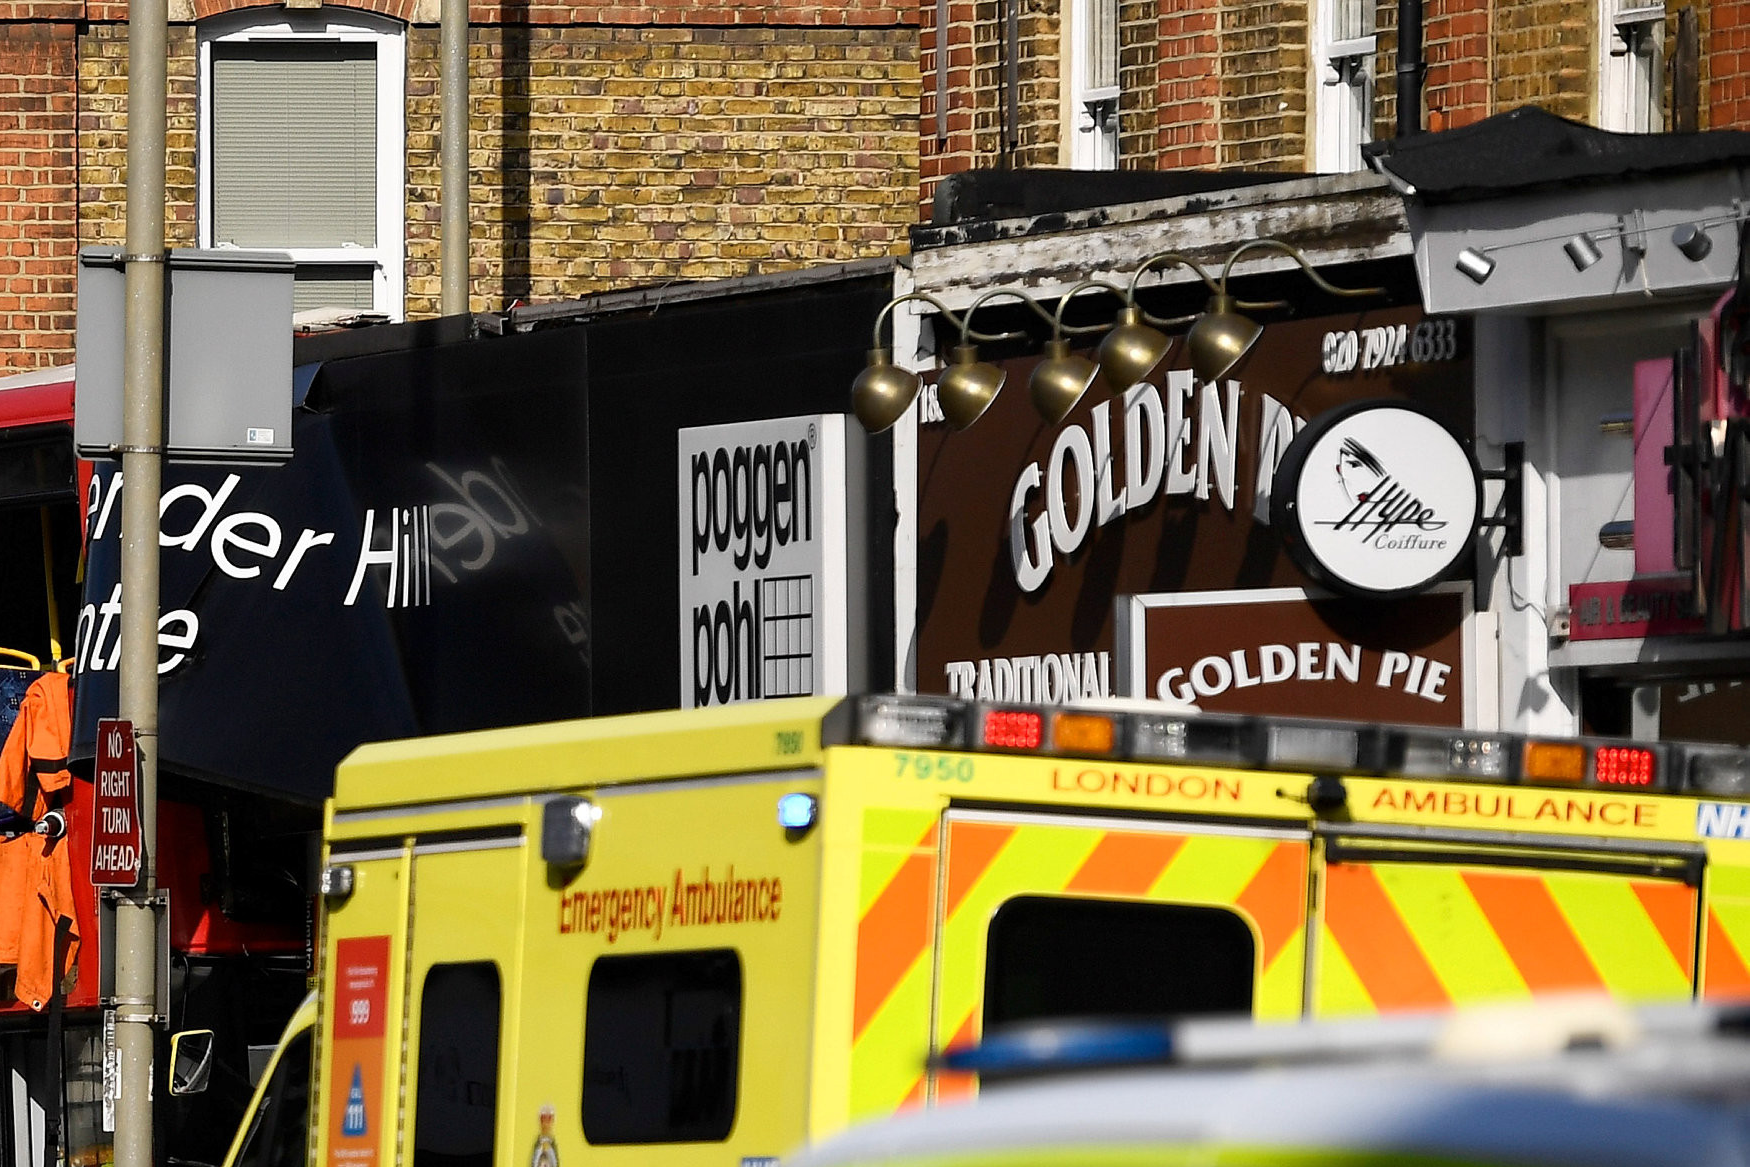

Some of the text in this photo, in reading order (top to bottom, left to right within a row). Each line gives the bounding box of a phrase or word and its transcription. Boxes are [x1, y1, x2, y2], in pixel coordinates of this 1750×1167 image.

[691, 438, 812, 576] poggen
[1009, 368, 1307, 592] GOLDEN P
[343, 503, 430, 608] Hill
[1374, 534, 1448, 550] Coiffure
[693, 578, 761, 709] pohl
[1156, 642, 1452, 705] GOLDEN PIE
[946, 650, 1116, 702] TRADITIONAL
[108, 732, 122, 758] NO
[101, 771, 130, 797] RIGHT
[895, 753, 1660, 830] 7950 LONDON AMBULANCE
[102, 808, 131, 834] TURN
[95, 845, 135, 871] AHEAD
[558, 869, 783, 943] Emergency Ambulance
